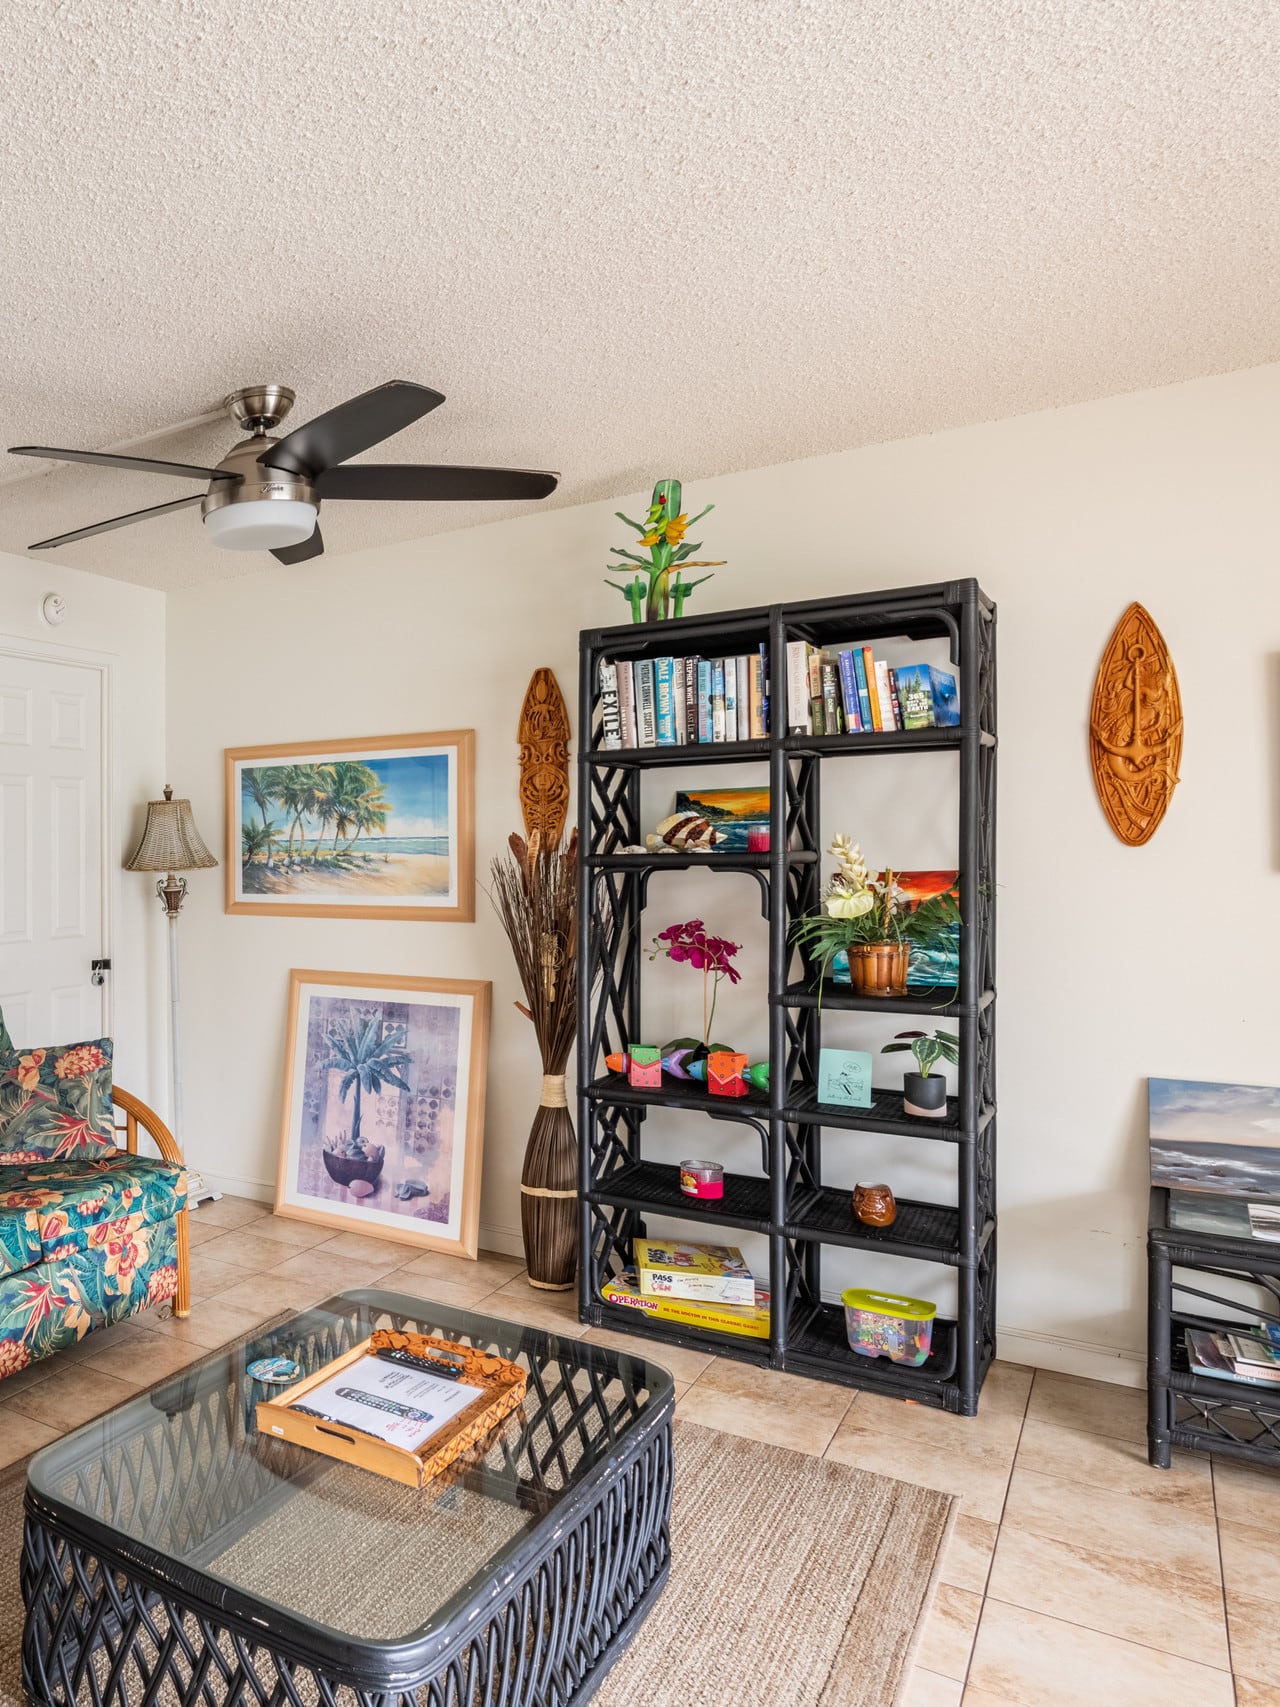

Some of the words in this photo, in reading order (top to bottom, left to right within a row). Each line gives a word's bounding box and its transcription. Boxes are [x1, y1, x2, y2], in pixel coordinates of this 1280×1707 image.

[640, 663, 650, 686] PATRICIA
[658, 659, 669, 680] DALE
[641, 686, 652, 710] CORNWELL
[659, 682, 670, 715] BROWN
[686, 686, 694, 705] WHITE
[908, 692, 924, 701] 365
[602, 690, 620, 738] EXILE
[643, 712, 654, 738] SCARPETTA
[652, 1273, 673, 1283] PASS
[609, 1293, 658, 1310] OPERATION
[681, 1311, 700, 1319] DOCTOR
